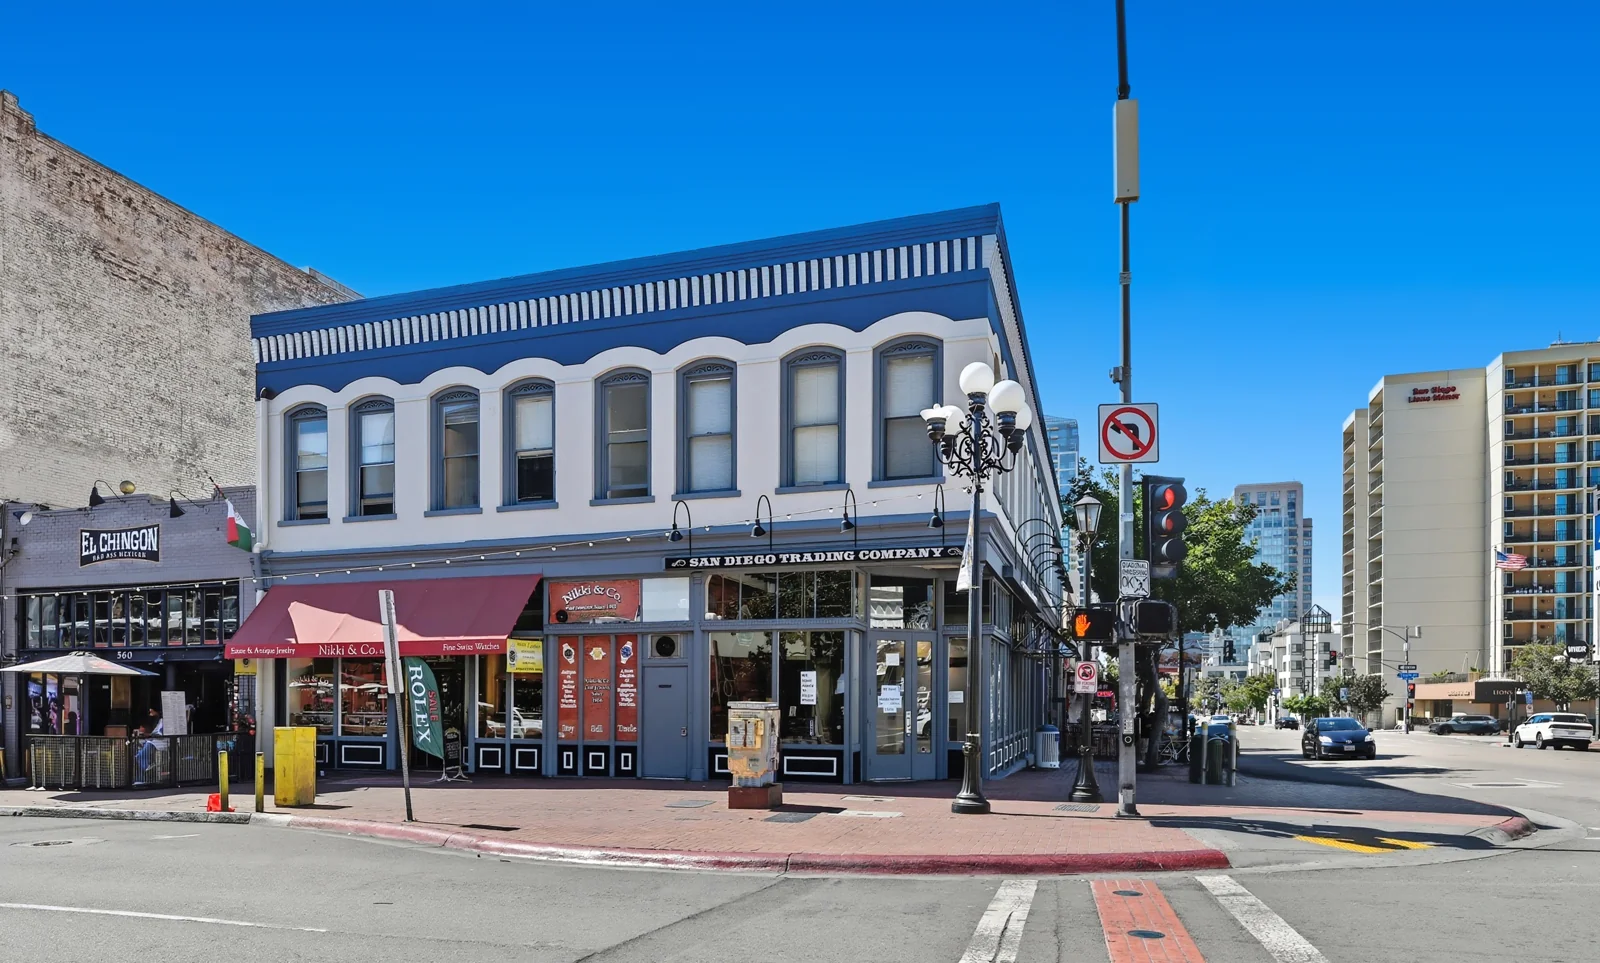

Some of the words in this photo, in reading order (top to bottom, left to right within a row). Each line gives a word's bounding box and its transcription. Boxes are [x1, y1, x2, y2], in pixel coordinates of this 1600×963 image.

[81, 532, 97, 556] EL
[100, 526, 158, 552] CHINGON
[689, 556, 721, 567] SAN
[724, 554, 776, 566] DIEGO
[779, 551, 855, 563] TRADING
[858, 547, 944, 560] COMPANY
[1122, 576, 1134, 588] OK
[593, 585, 605, 595] &
[276, 646, 296, 655] Jewelry
[318, 644, 345, 656] Nikki
[347, 644, 358, 655] &
[442, 643, 456, 652] Fine
[456, 643, 473, 652] Swiss
[474, 641, 500, 651] Watches
[116, 651, 133, 660] 560
[408, 664, 432, 743] ROLEX
[428, 690, 439, 723] SALE
